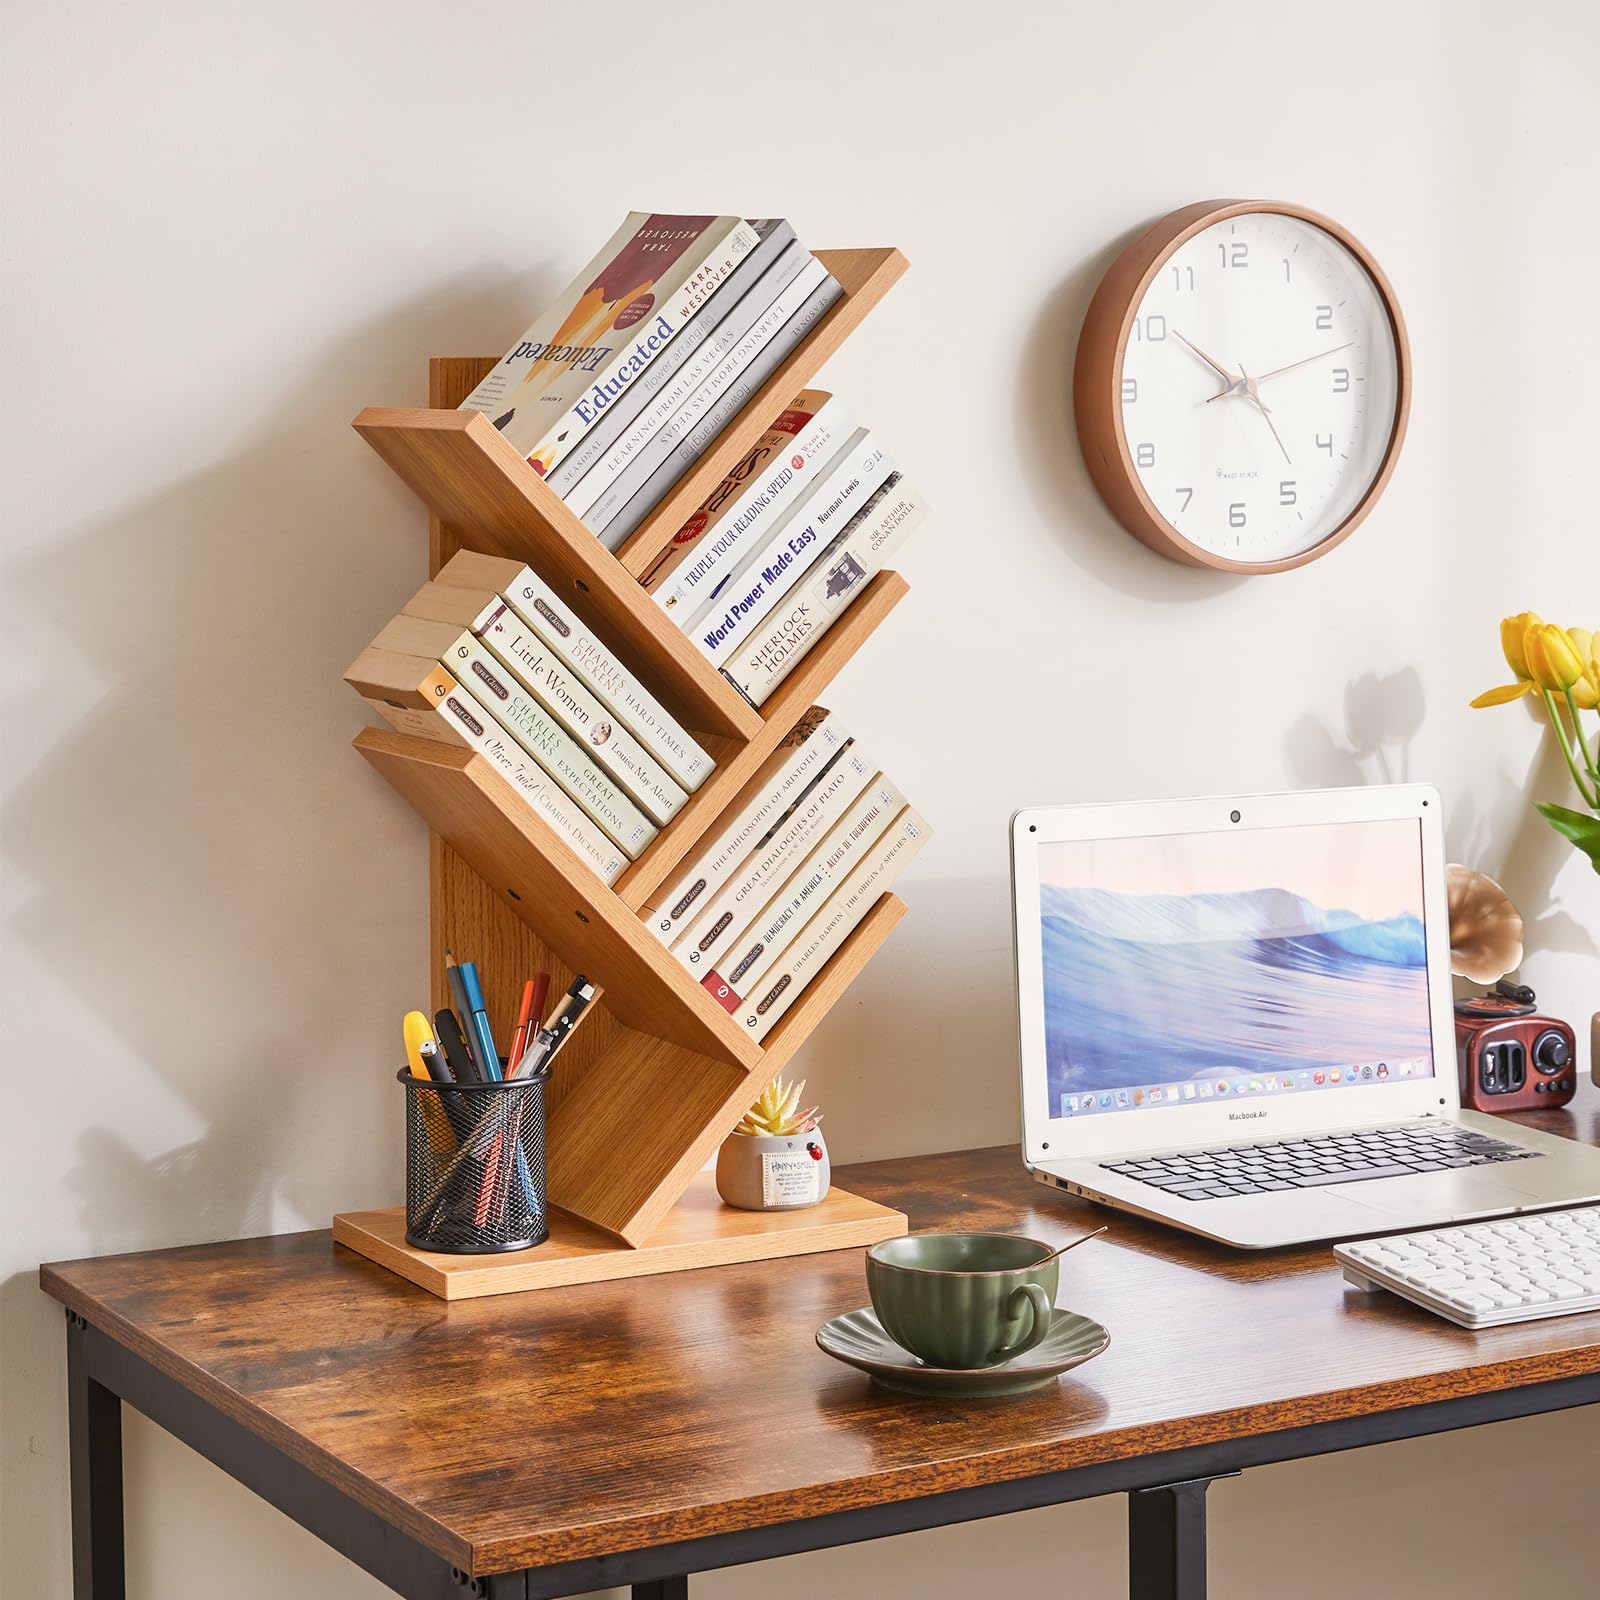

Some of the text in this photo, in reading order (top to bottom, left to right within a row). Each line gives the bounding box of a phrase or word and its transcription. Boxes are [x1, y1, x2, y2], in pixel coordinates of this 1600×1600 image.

[637, 230, 699, 240] WESTOVER
[642, 243, 673, 252] TARA
[1218, 242, 1248, 269] 12
[679, 260, 734, 319] WESTOVER
[684, 266, 713, 295] TARA
[1172, 266, 1194, 291] 11
[1282, 258, 1290, 283] 1
[792, 296, 831, 340] SEASONAL
[1135, 315, 1166, 342] 10
[1315, 305, 1333, 330] 2
[506, 341, 613, 372] Educated
[572, 316, 675, 425] Educated
[660, 306, 785, 446] LEARNING FROM LAS VEGAS
[1332, 368, 1349, 393] 3
[563, 312, 714, 483] SEASONAL flower arranging
[607, 330, 734, 471] LEARNING FROM LAS VEGAS
[723, 383, 752, 419] flower
[679, 414, 726, 464] arranging
[1137, 443, 1155, 468] 8
[1315, 433, 1333, 457] 4
[1175, 487, 1193, 513] 7
[1229, 503, 1246, 528] 6
[1279, 481, 1297, 506] 5
[684, 552, 716, 587] TRIPLE
[711, 529, 738, 558] YOUR
[732, 492, 771, 535] READING
[766, 468, 793, 499] SPEED
[870, 501, 907, 542] SIR ARTHUR
[871, 503, 915, 551] CONAN DOYLE
[703, 478, 860, 650] Word Power Made Easy Norman Lewis
[750, 602, 810, 671] SHERLOCK
[764, 618, 812, 673] HOLMES
[510, 635, 589, 724] Little Women
[571, 645, 622, 697] DICKENS
[578, 637, 627, 689] CHARLES
[506, 704, 558, 756] DICKENS
[513, 696, 562, 748] CHARLES
[625, 694, 686, 759] HARD TIMES
[484, 739, 540, 792] Oliver Twist
[583, 769, 615, 800] GREAT
[611, 742, 673, 809] Louisa May Alcott
[557, 759, 624, 830] EXPECTATIONS
[712, 750, 818, 872] THE PHILOSOPHY OF ARISTOTLE
[735, 871, 762, 902] GREAT
[761, 817, 808, 872] DIALOGUES
[807, 803, 819, 818] OF
[818, 774, 845, 805] PLATO
[826, 806, 880, 869] ALEXIS DE TOCQUEVILLE
[845, 895, 859, 909] THE
[857, 872, 879, 895] ORIGIN
[883, 836, 907, 865] SPECIES
[762, 873, 824, 944] DEMOCRACY IN AMERICA
[792, 912, 844, 973] CHARLES DARWIN
[1229, 1112, 1257, 1120] Macbook
